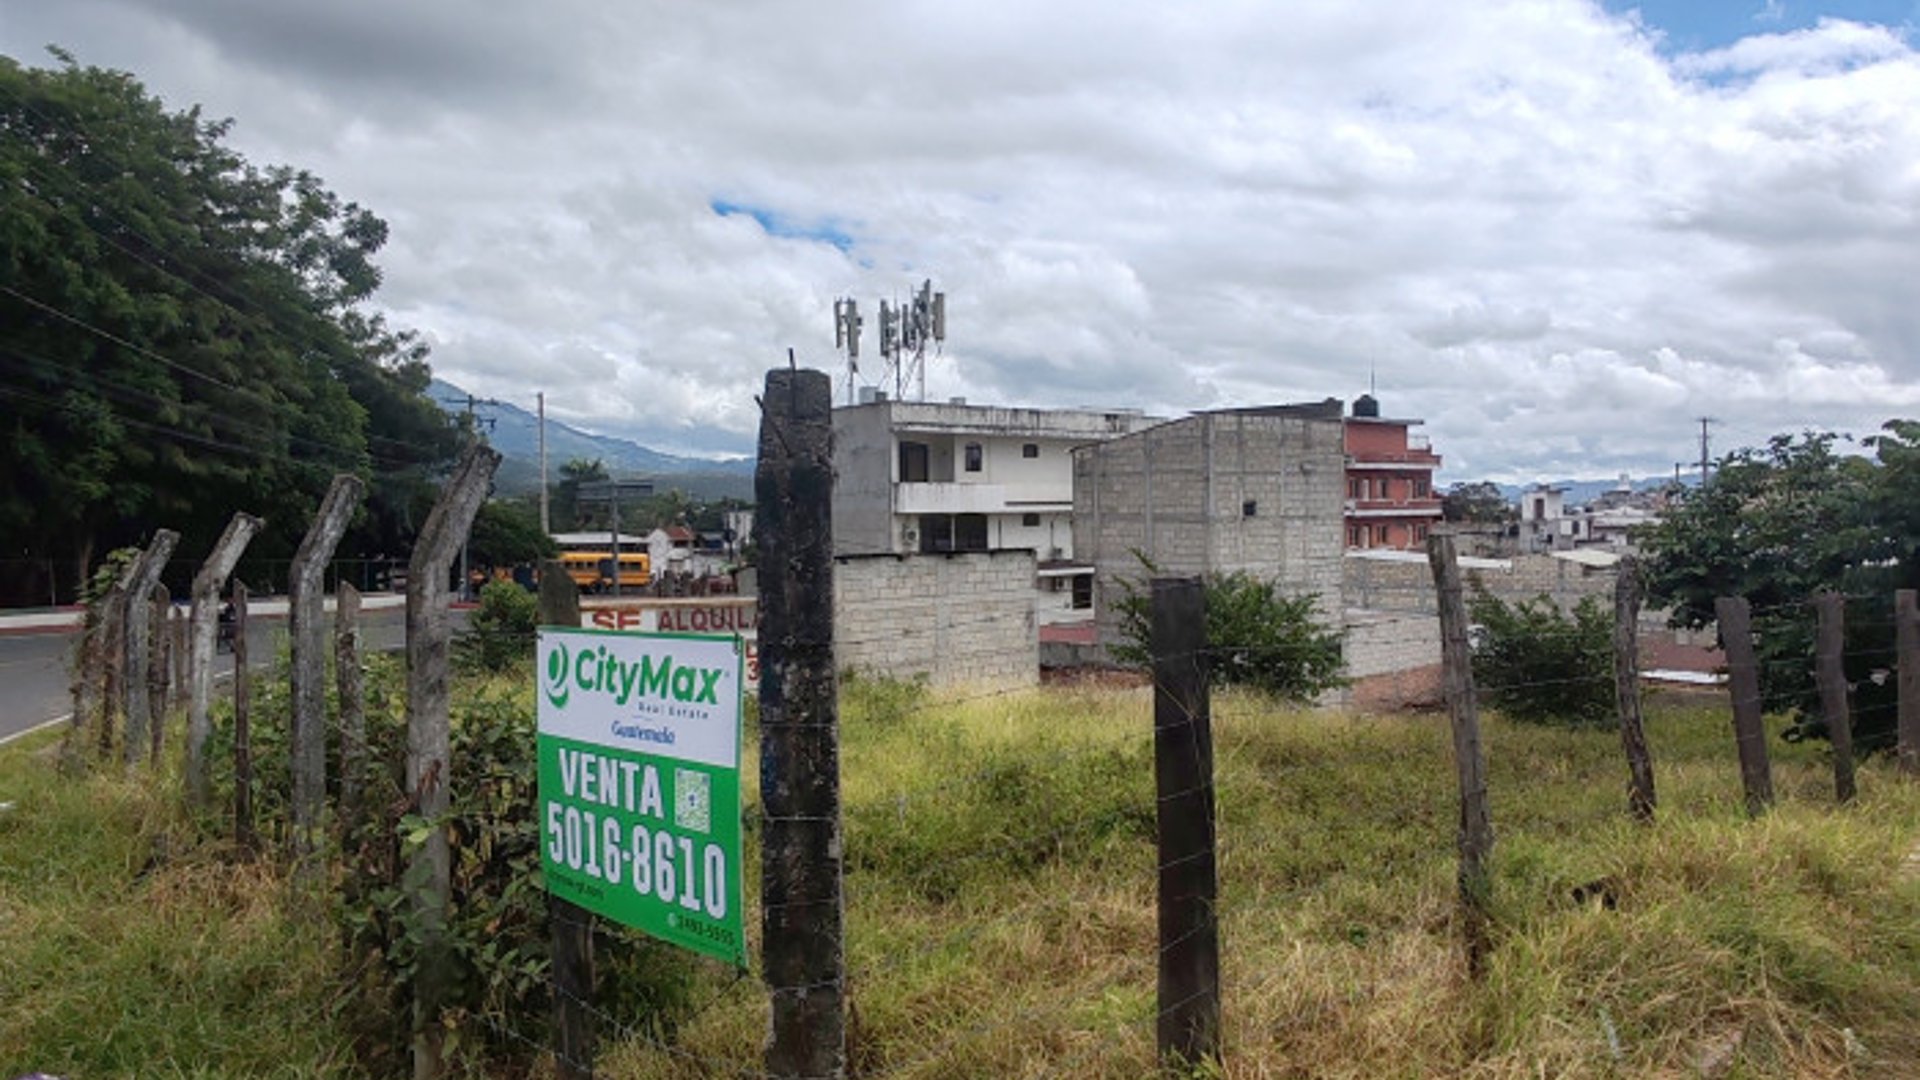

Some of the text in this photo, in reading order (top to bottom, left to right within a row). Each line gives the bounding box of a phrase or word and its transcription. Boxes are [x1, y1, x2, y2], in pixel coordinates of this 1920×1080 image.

[592, 608, 642, 630] SE
[575, 644, 723, 706] CityMax
[638, 701, 709, 720] Real Estate
[611, 720, 676, 745] Guatemala
[558, 747, 665, 820] VENTA
[547, 800, 727, 920] 5016-8610
